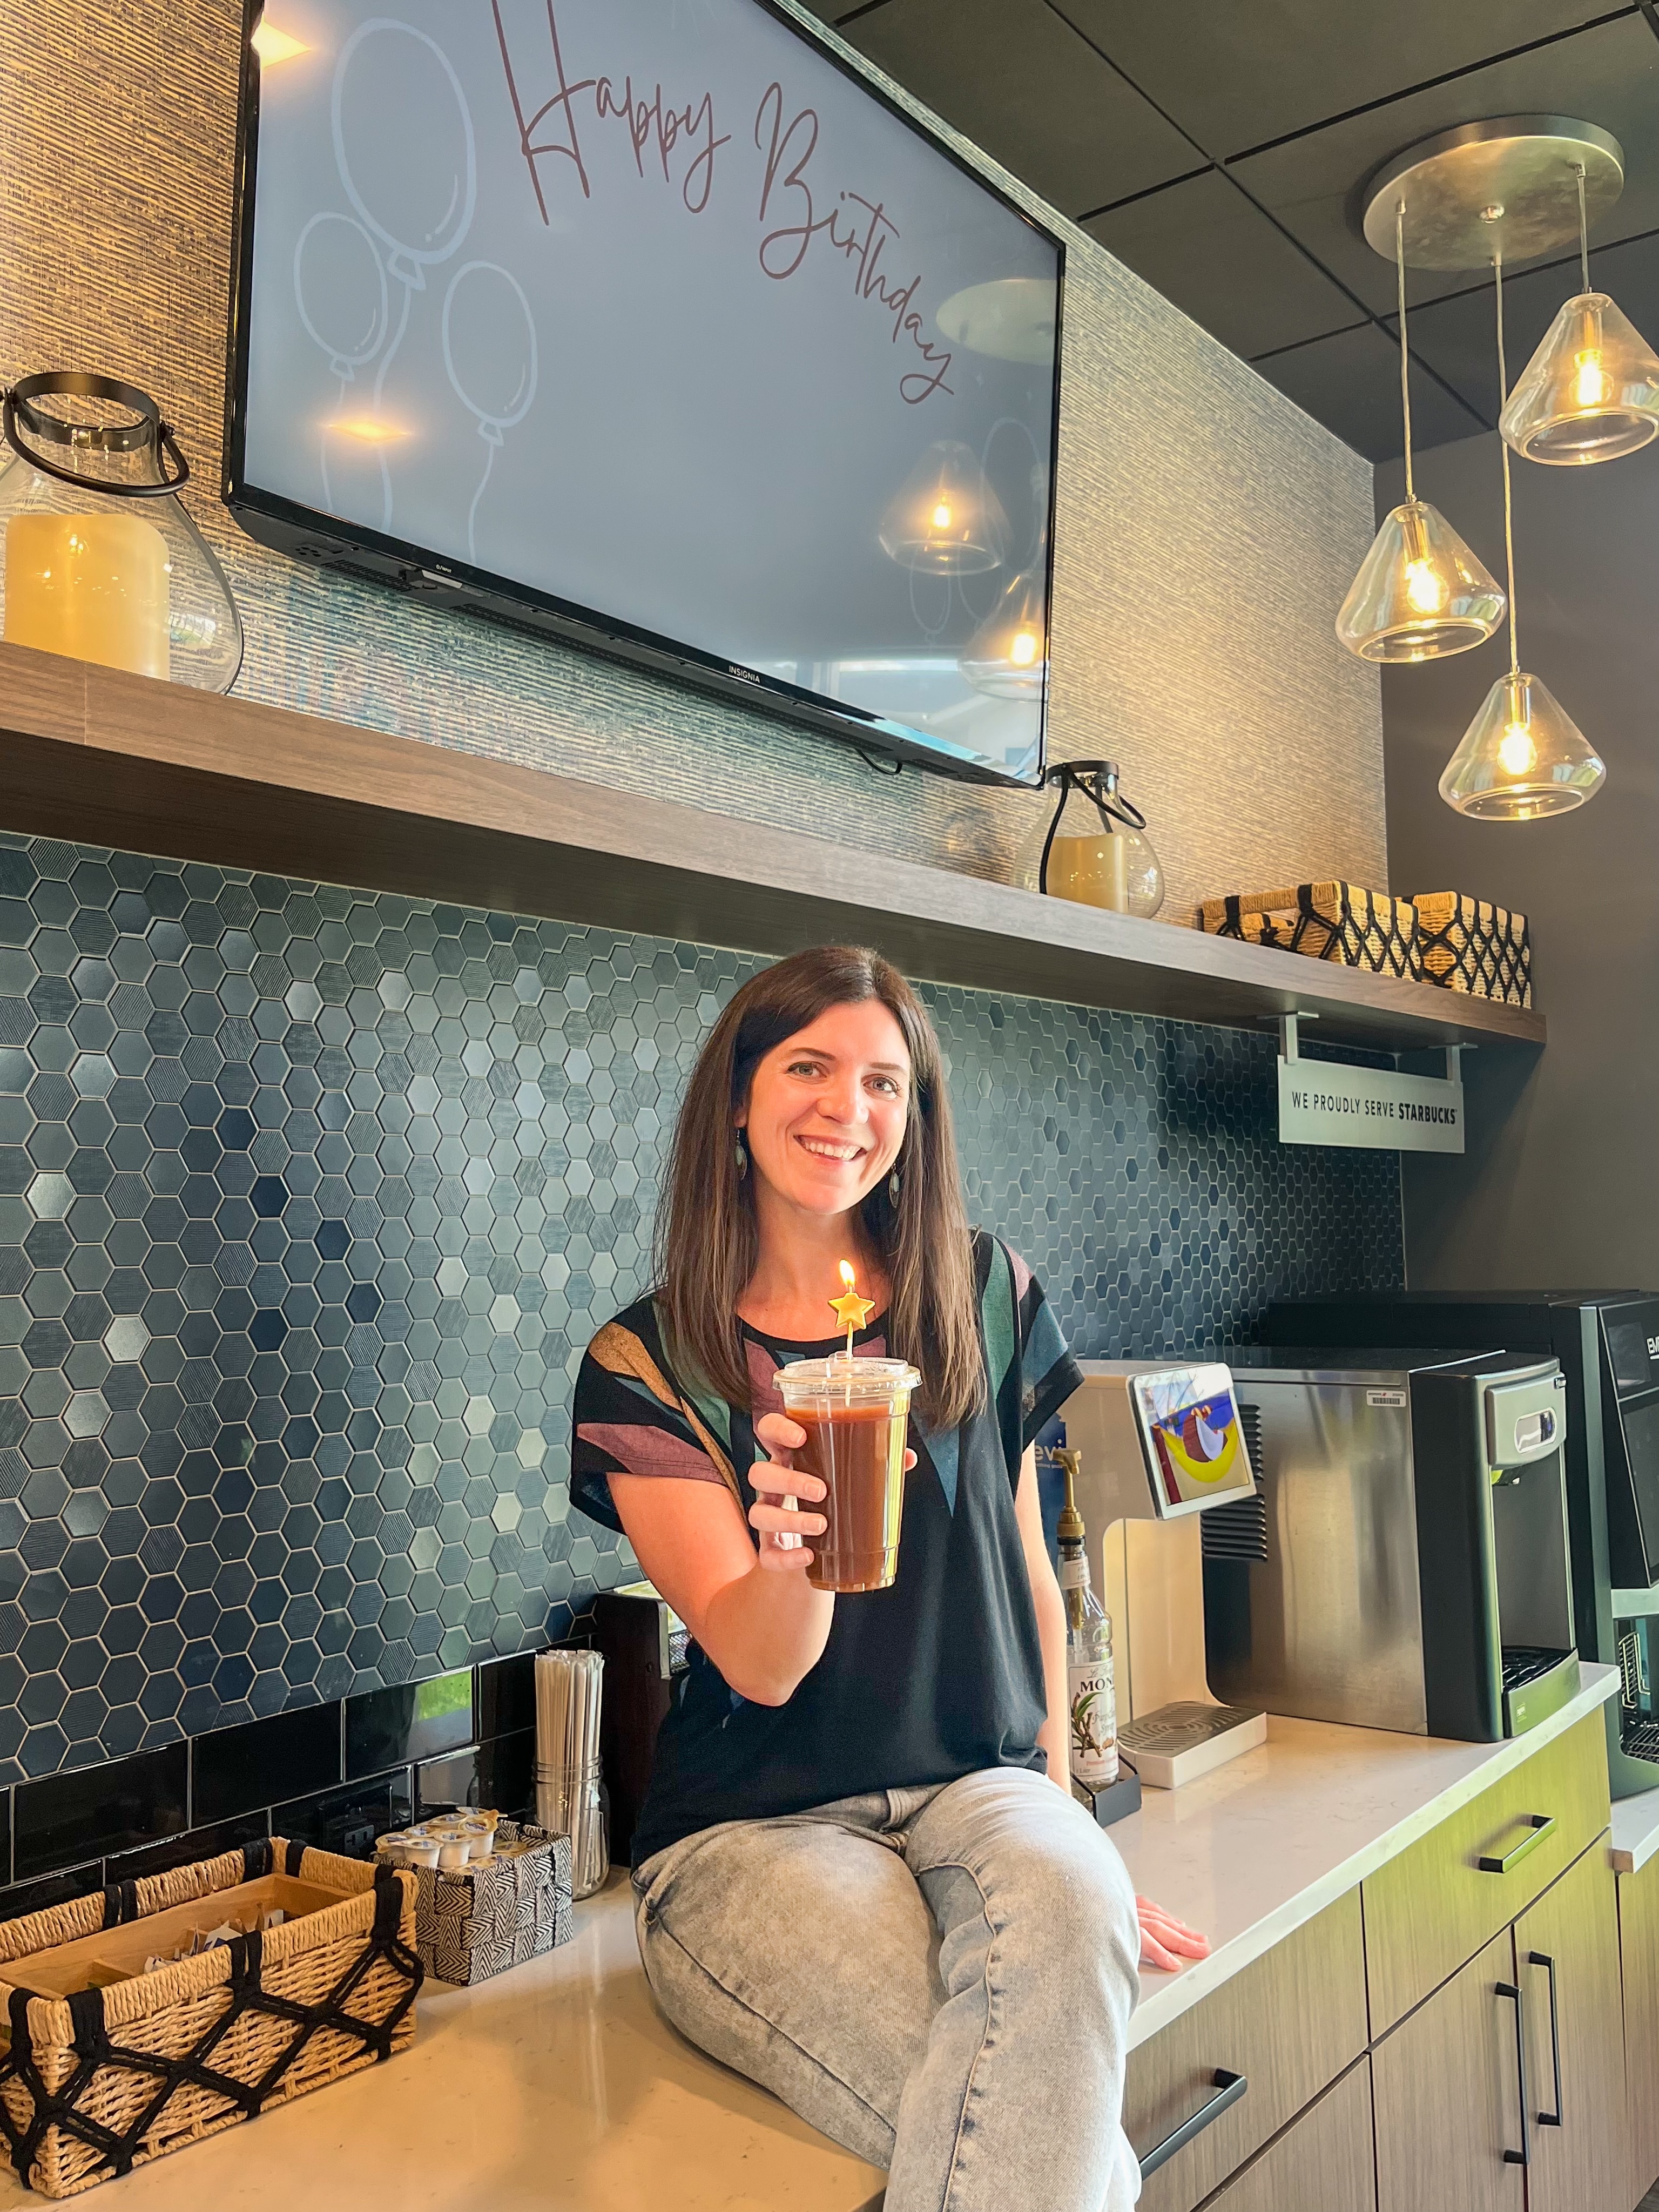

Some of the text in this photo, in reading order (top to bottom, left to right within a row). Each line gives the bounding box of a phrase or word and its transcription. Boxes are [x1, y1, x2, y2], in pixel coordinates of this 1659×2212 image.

[493, 0, 954, 404] Happy Birthday
[729, 665, 760, 683] INSIGNIA
[1292, 1091, 1456, 1124] WE PROUDLY SERVE STARBUCKS
[1035, 1439, 1062, 1461] ev
